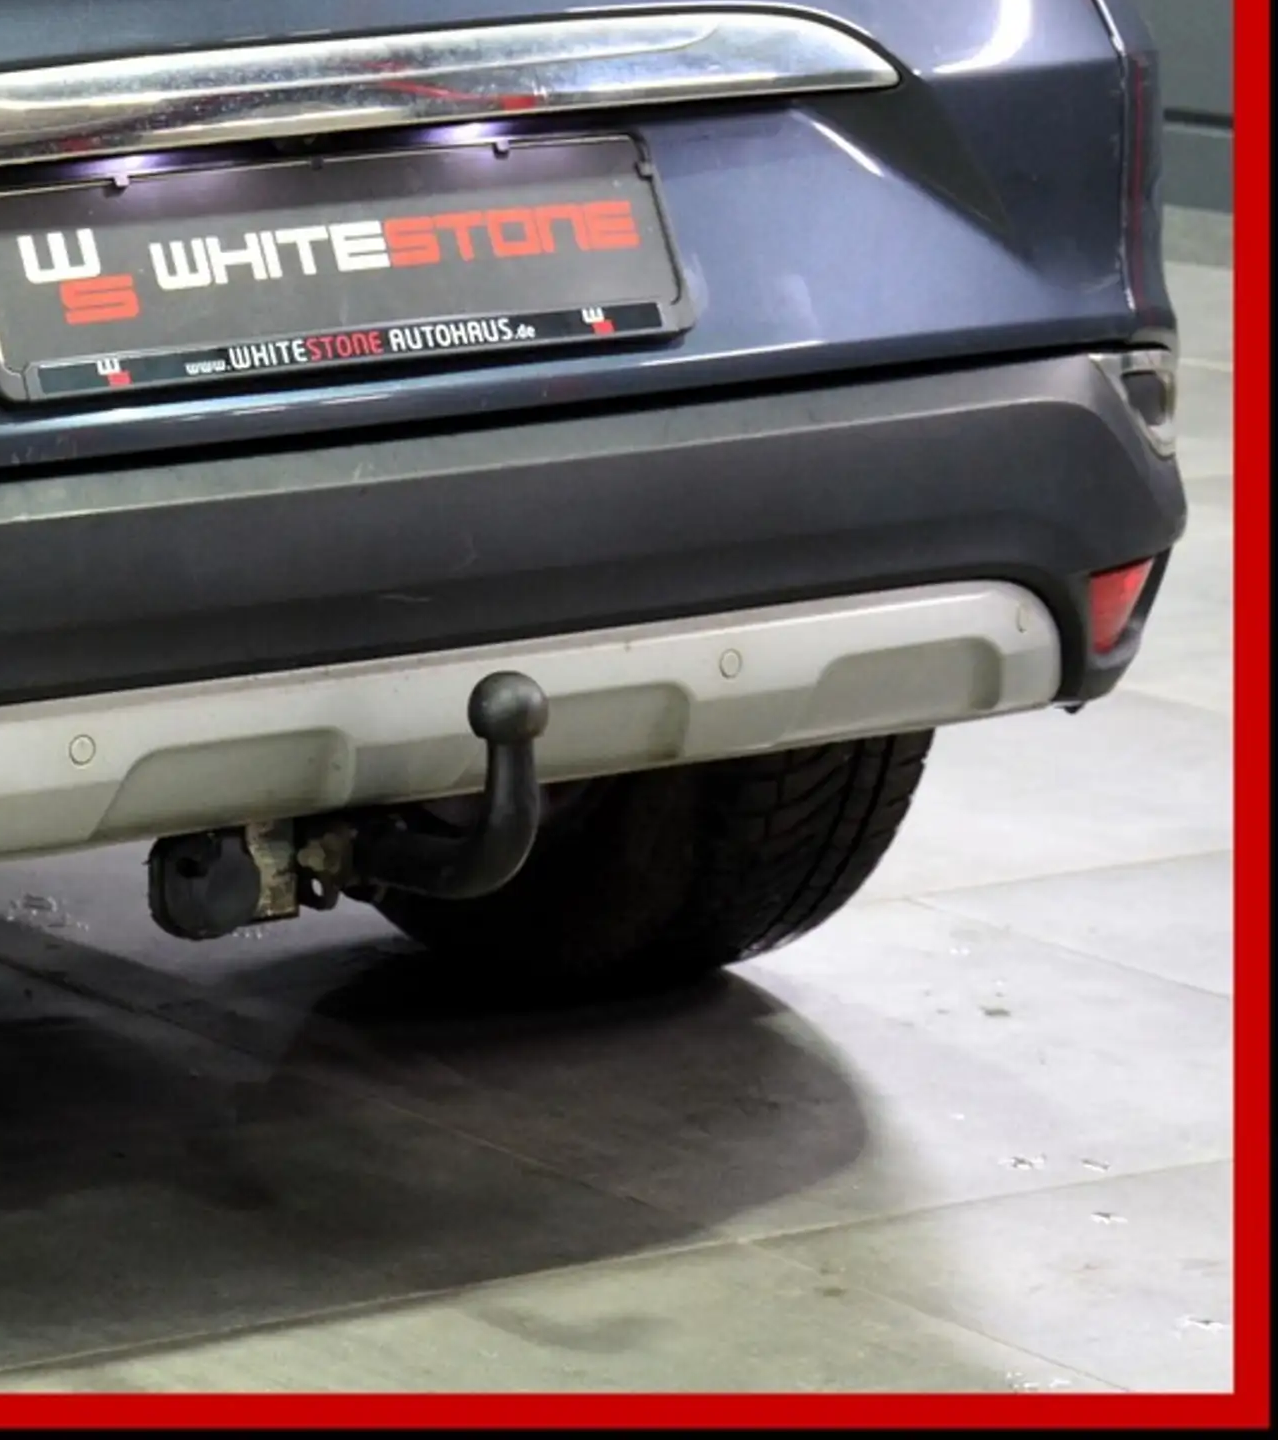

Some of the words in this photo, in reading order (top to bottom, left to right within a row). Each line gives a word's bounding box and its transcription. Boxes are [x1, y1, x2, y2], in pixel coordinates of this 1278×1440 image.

[148, 201, 640, 291] WHITESTONE
[185, 331, 383, 375] www.WHITESTONE
[388, 318, 536, 352] AUTOHAUS.de
